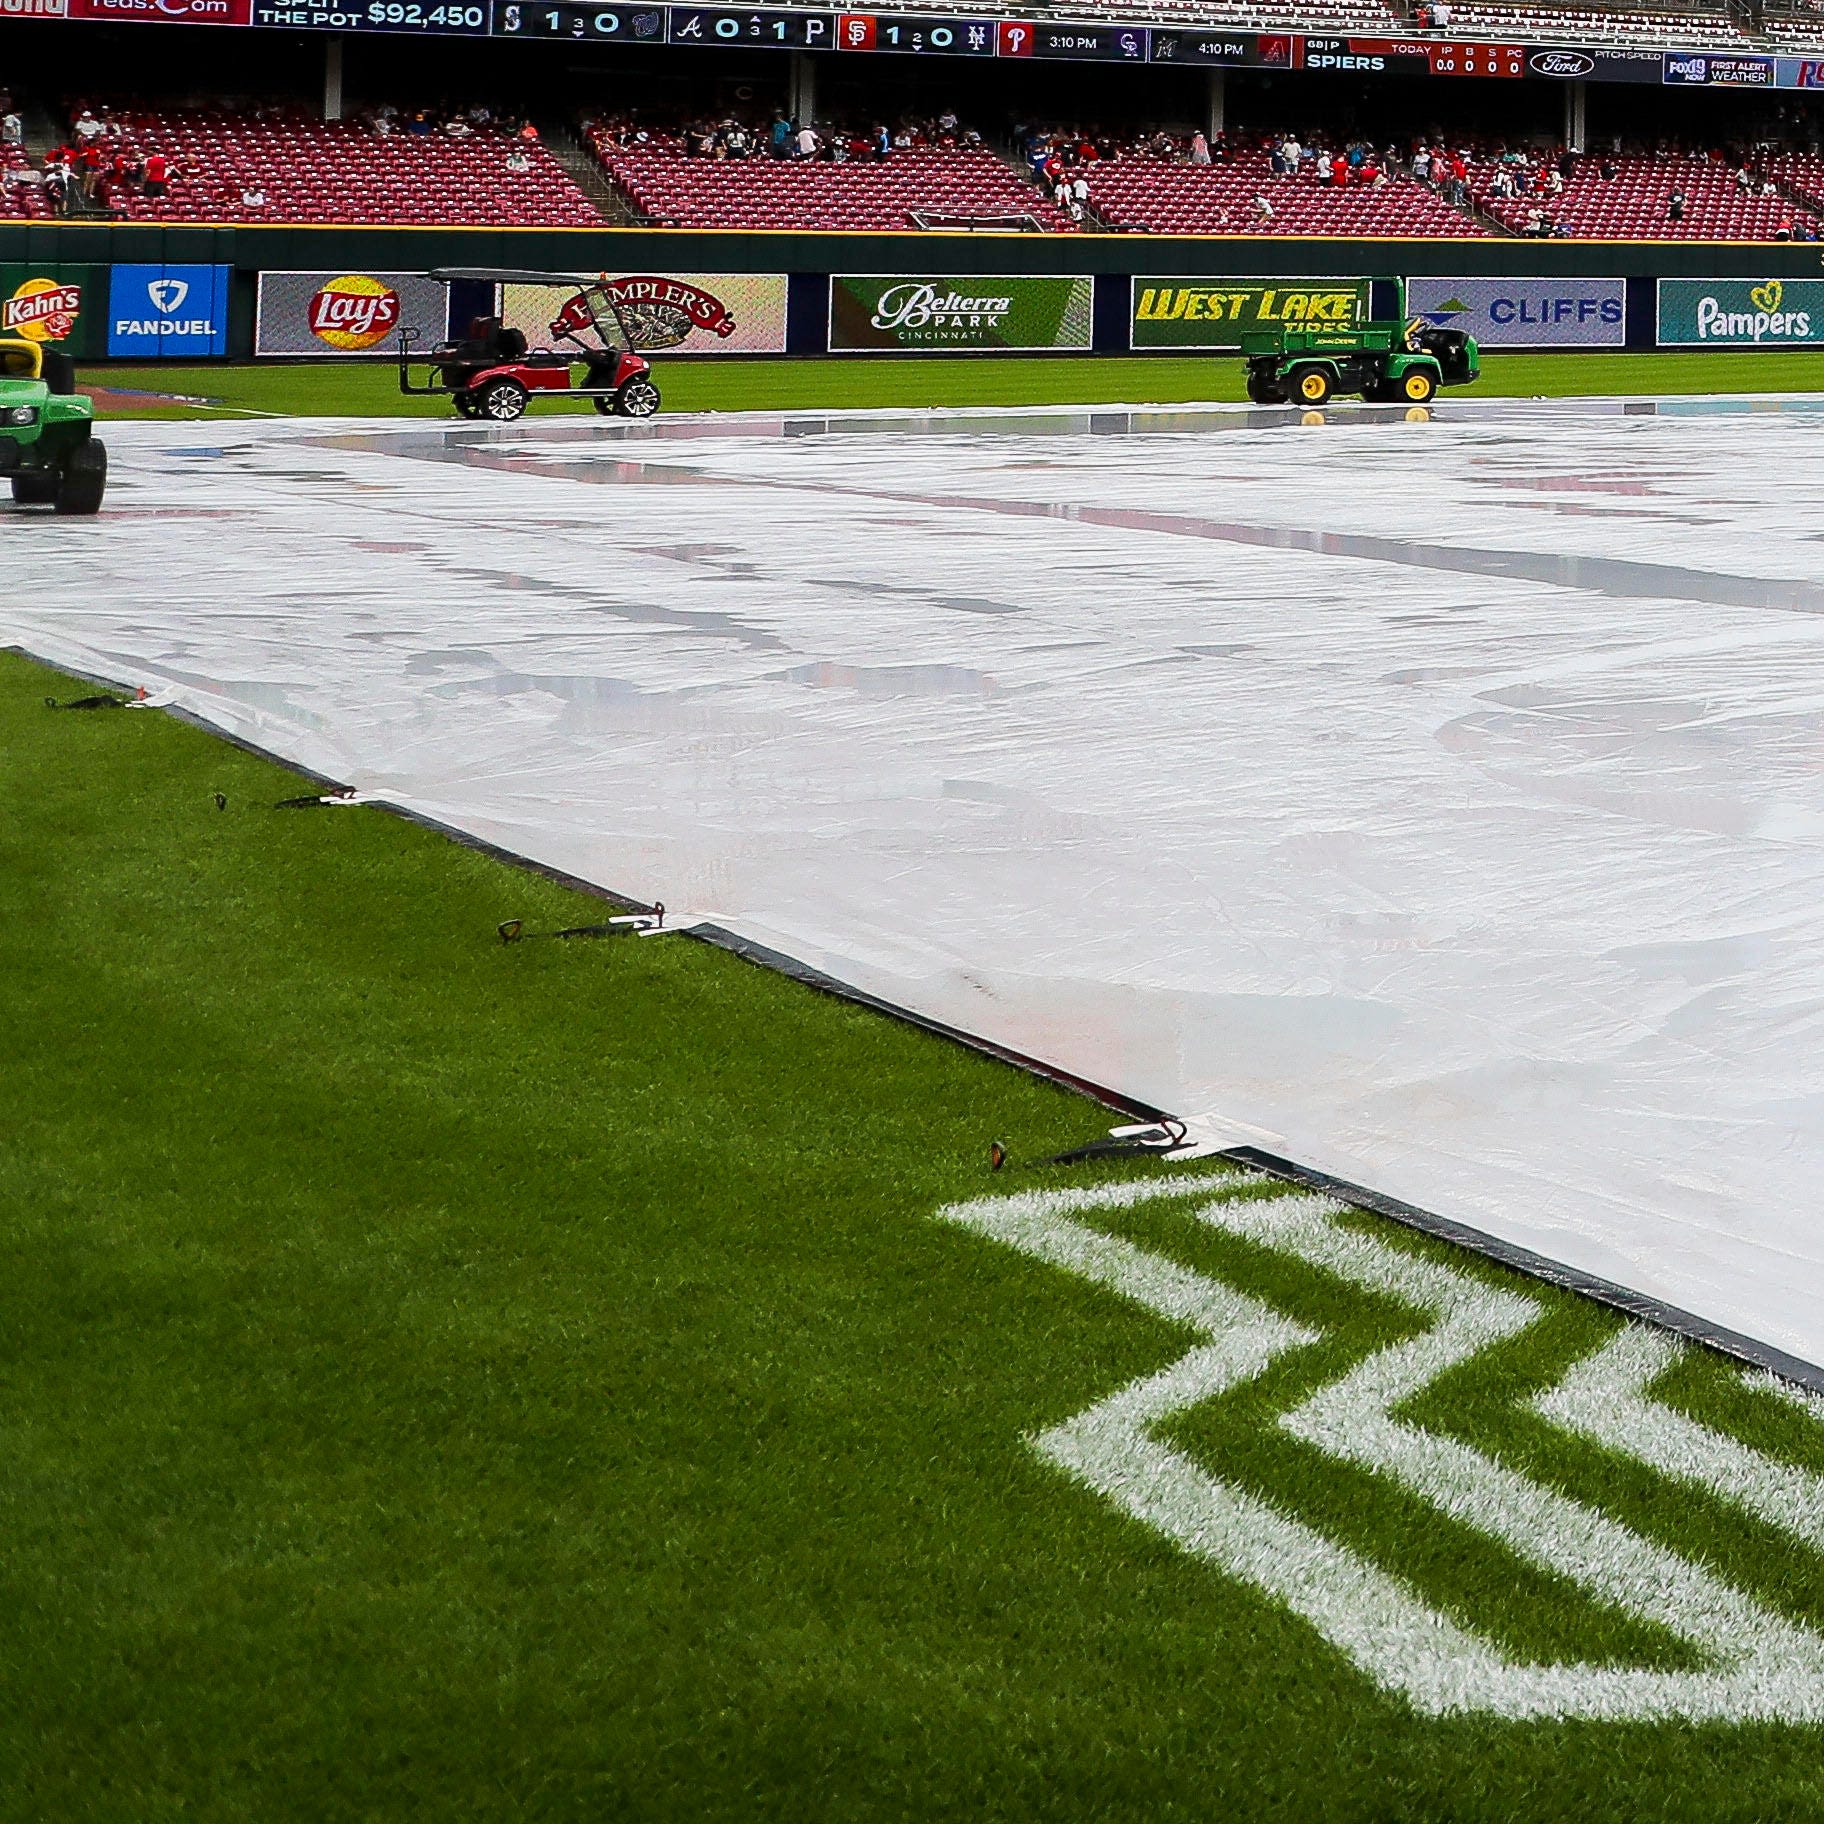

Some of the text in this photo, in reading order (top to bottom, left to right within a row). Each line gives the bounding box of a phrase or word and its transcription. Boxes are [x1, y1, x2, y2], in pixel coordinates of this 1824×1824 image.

[259, 9, 363, 26] THE POT
[368, 2, 483, 29] $92,450
[1049, 36, 1097, 49] 3:10 PM
[1199, 43, 1244, 56] 4:10 PM
[1392, 44, 1431, 54] TODAY
[1307, 55, 1454, 71] SPIERS 0.0
[1627, 51, 1661, 60] SPEED
[1541, 55, 1583, 74] Ford
[1711, 61, 1767, 72] FIRST ALERT
[1711, 71, 1766, 83] WEATHER
[8, 291, 79, 325] Kahn's
[871, 284, 1010, 330] Belterra
[1136, 289, 1356, 320] WEST LAKE
[1489, 296, 1623, 324] CLIFFS
[314, 293, 395, 334] Lay's
[935, 316, 998, 326] PARK
[1698, 296, 1810, 342] Pampers
[116, 320, 217, 335] FANDUEL
